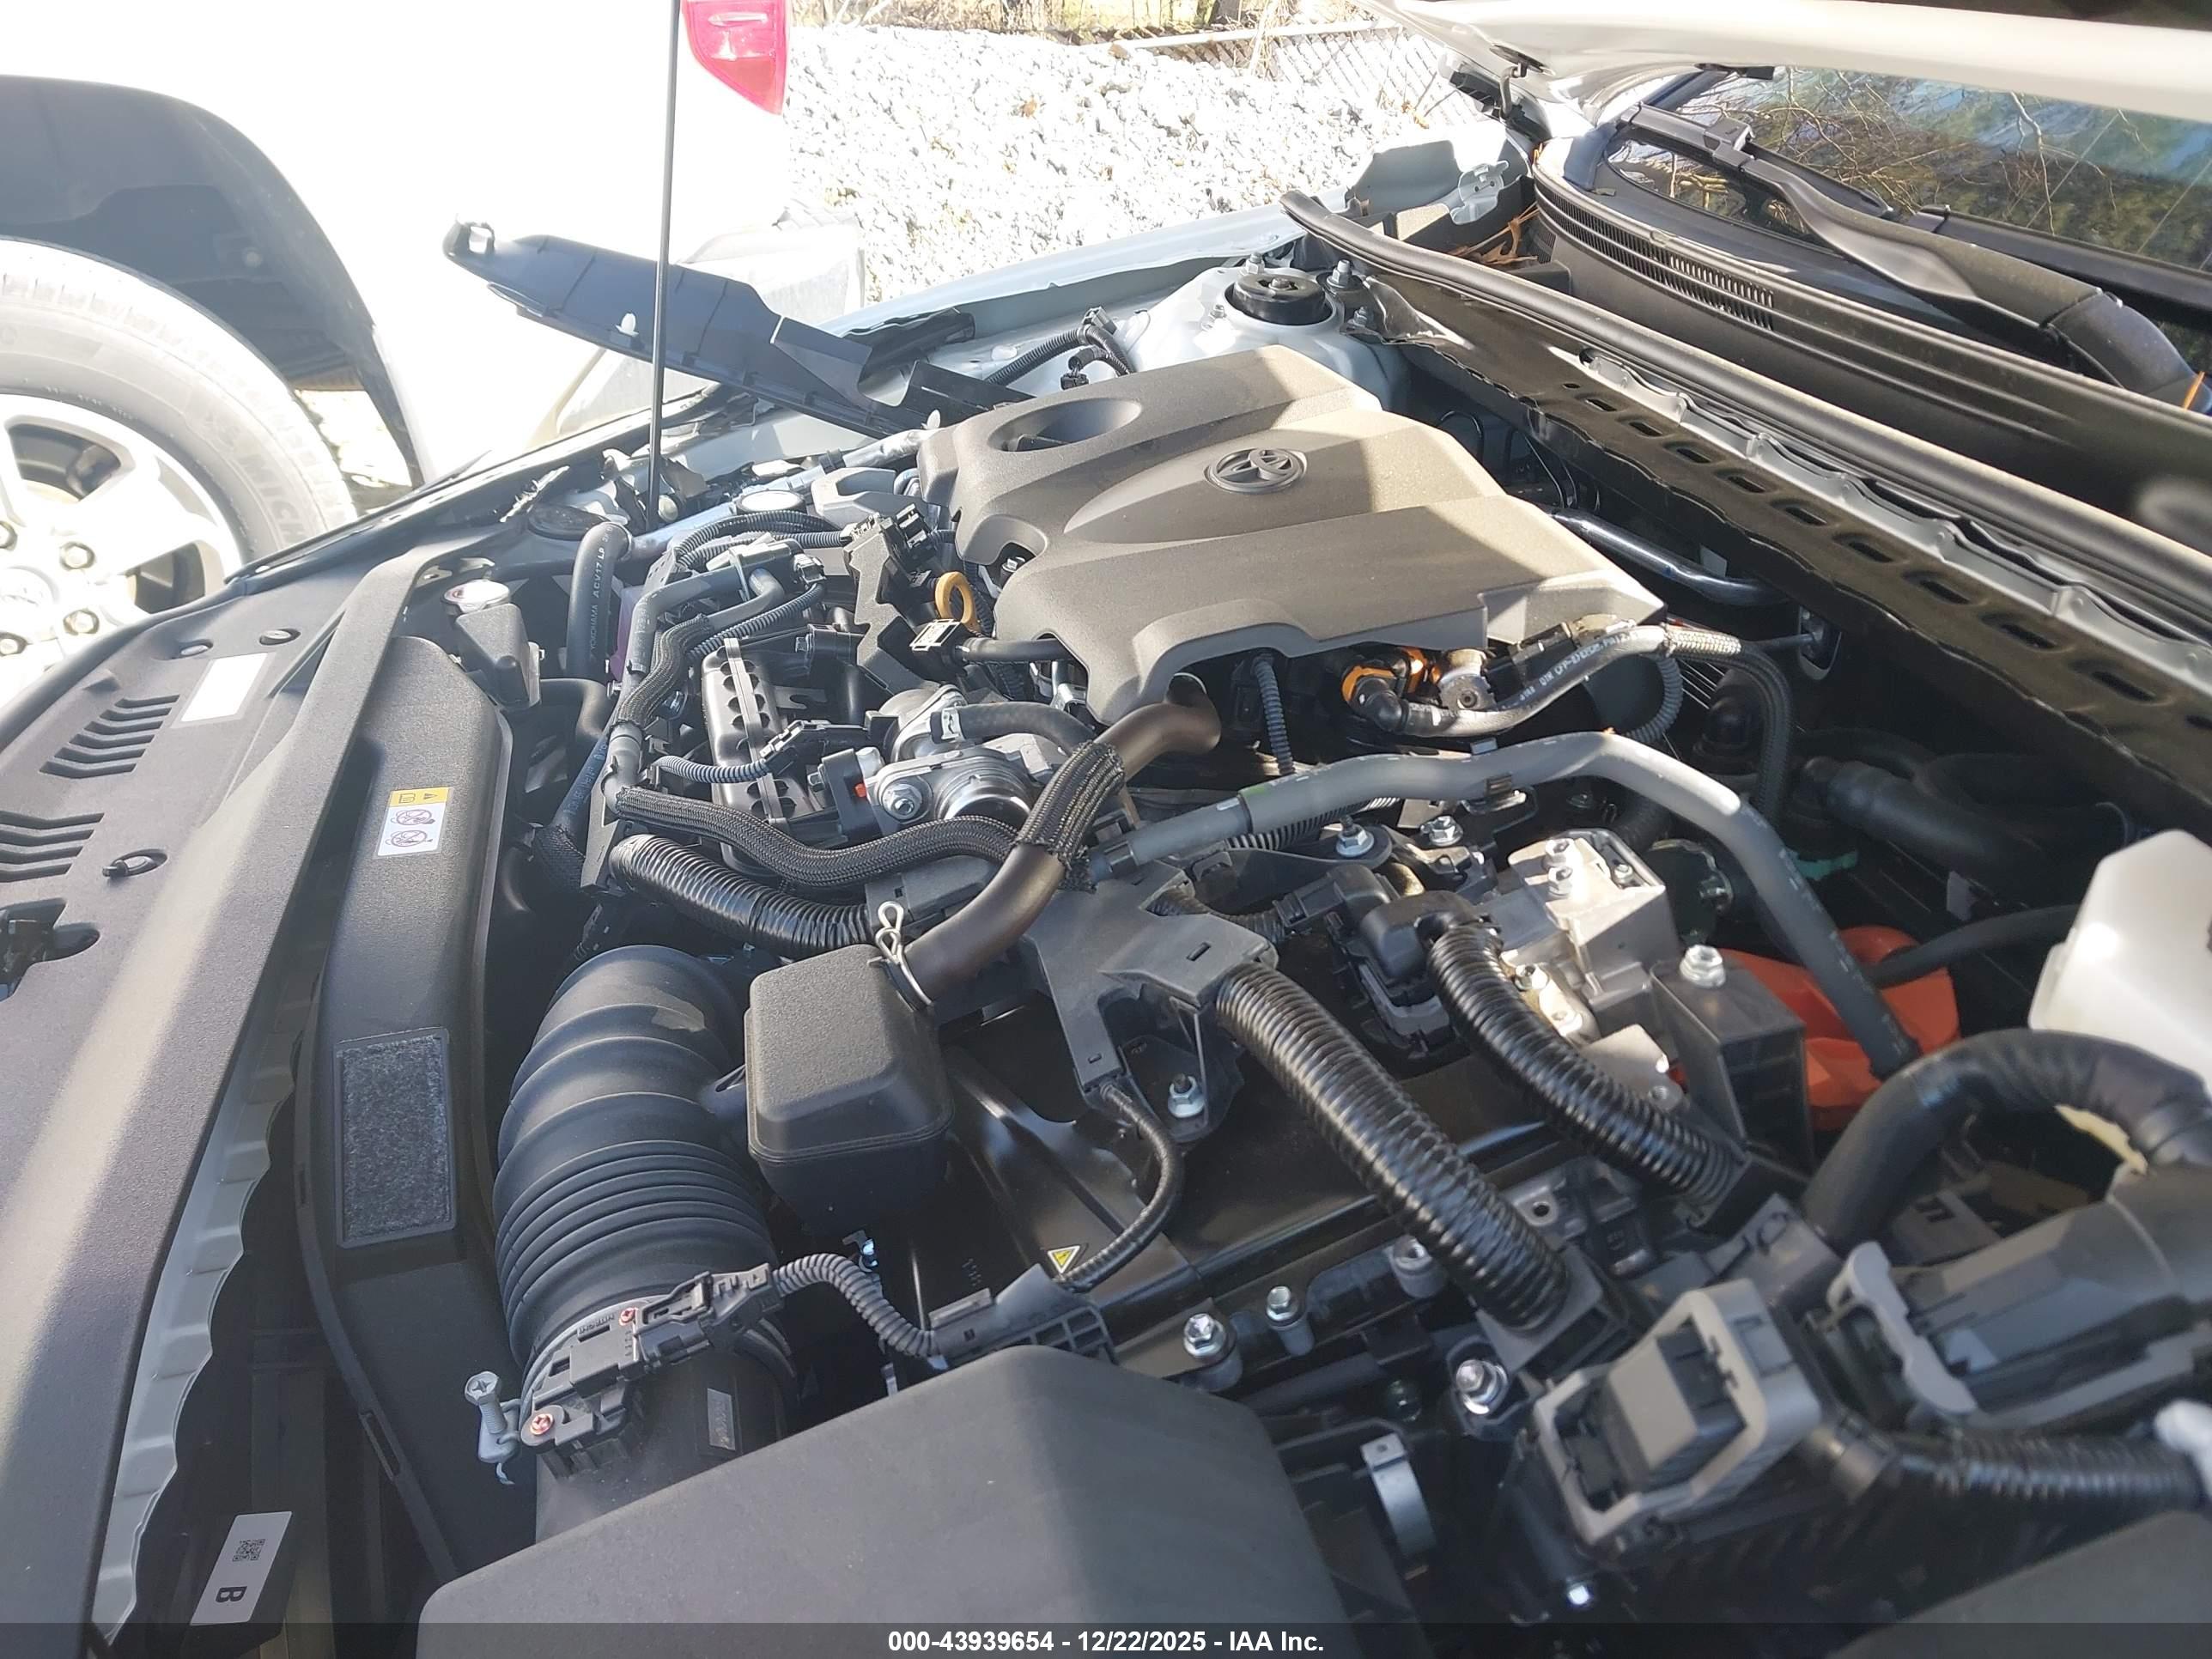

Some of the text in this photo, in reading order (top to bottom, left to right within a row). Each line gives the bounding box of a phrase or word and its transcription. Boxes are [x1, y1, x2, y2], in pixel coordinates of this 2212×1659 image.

[590, 546, 605, 650] YOKOHAMA ACV17 LP
[215, 1585, 247, 1603] B
